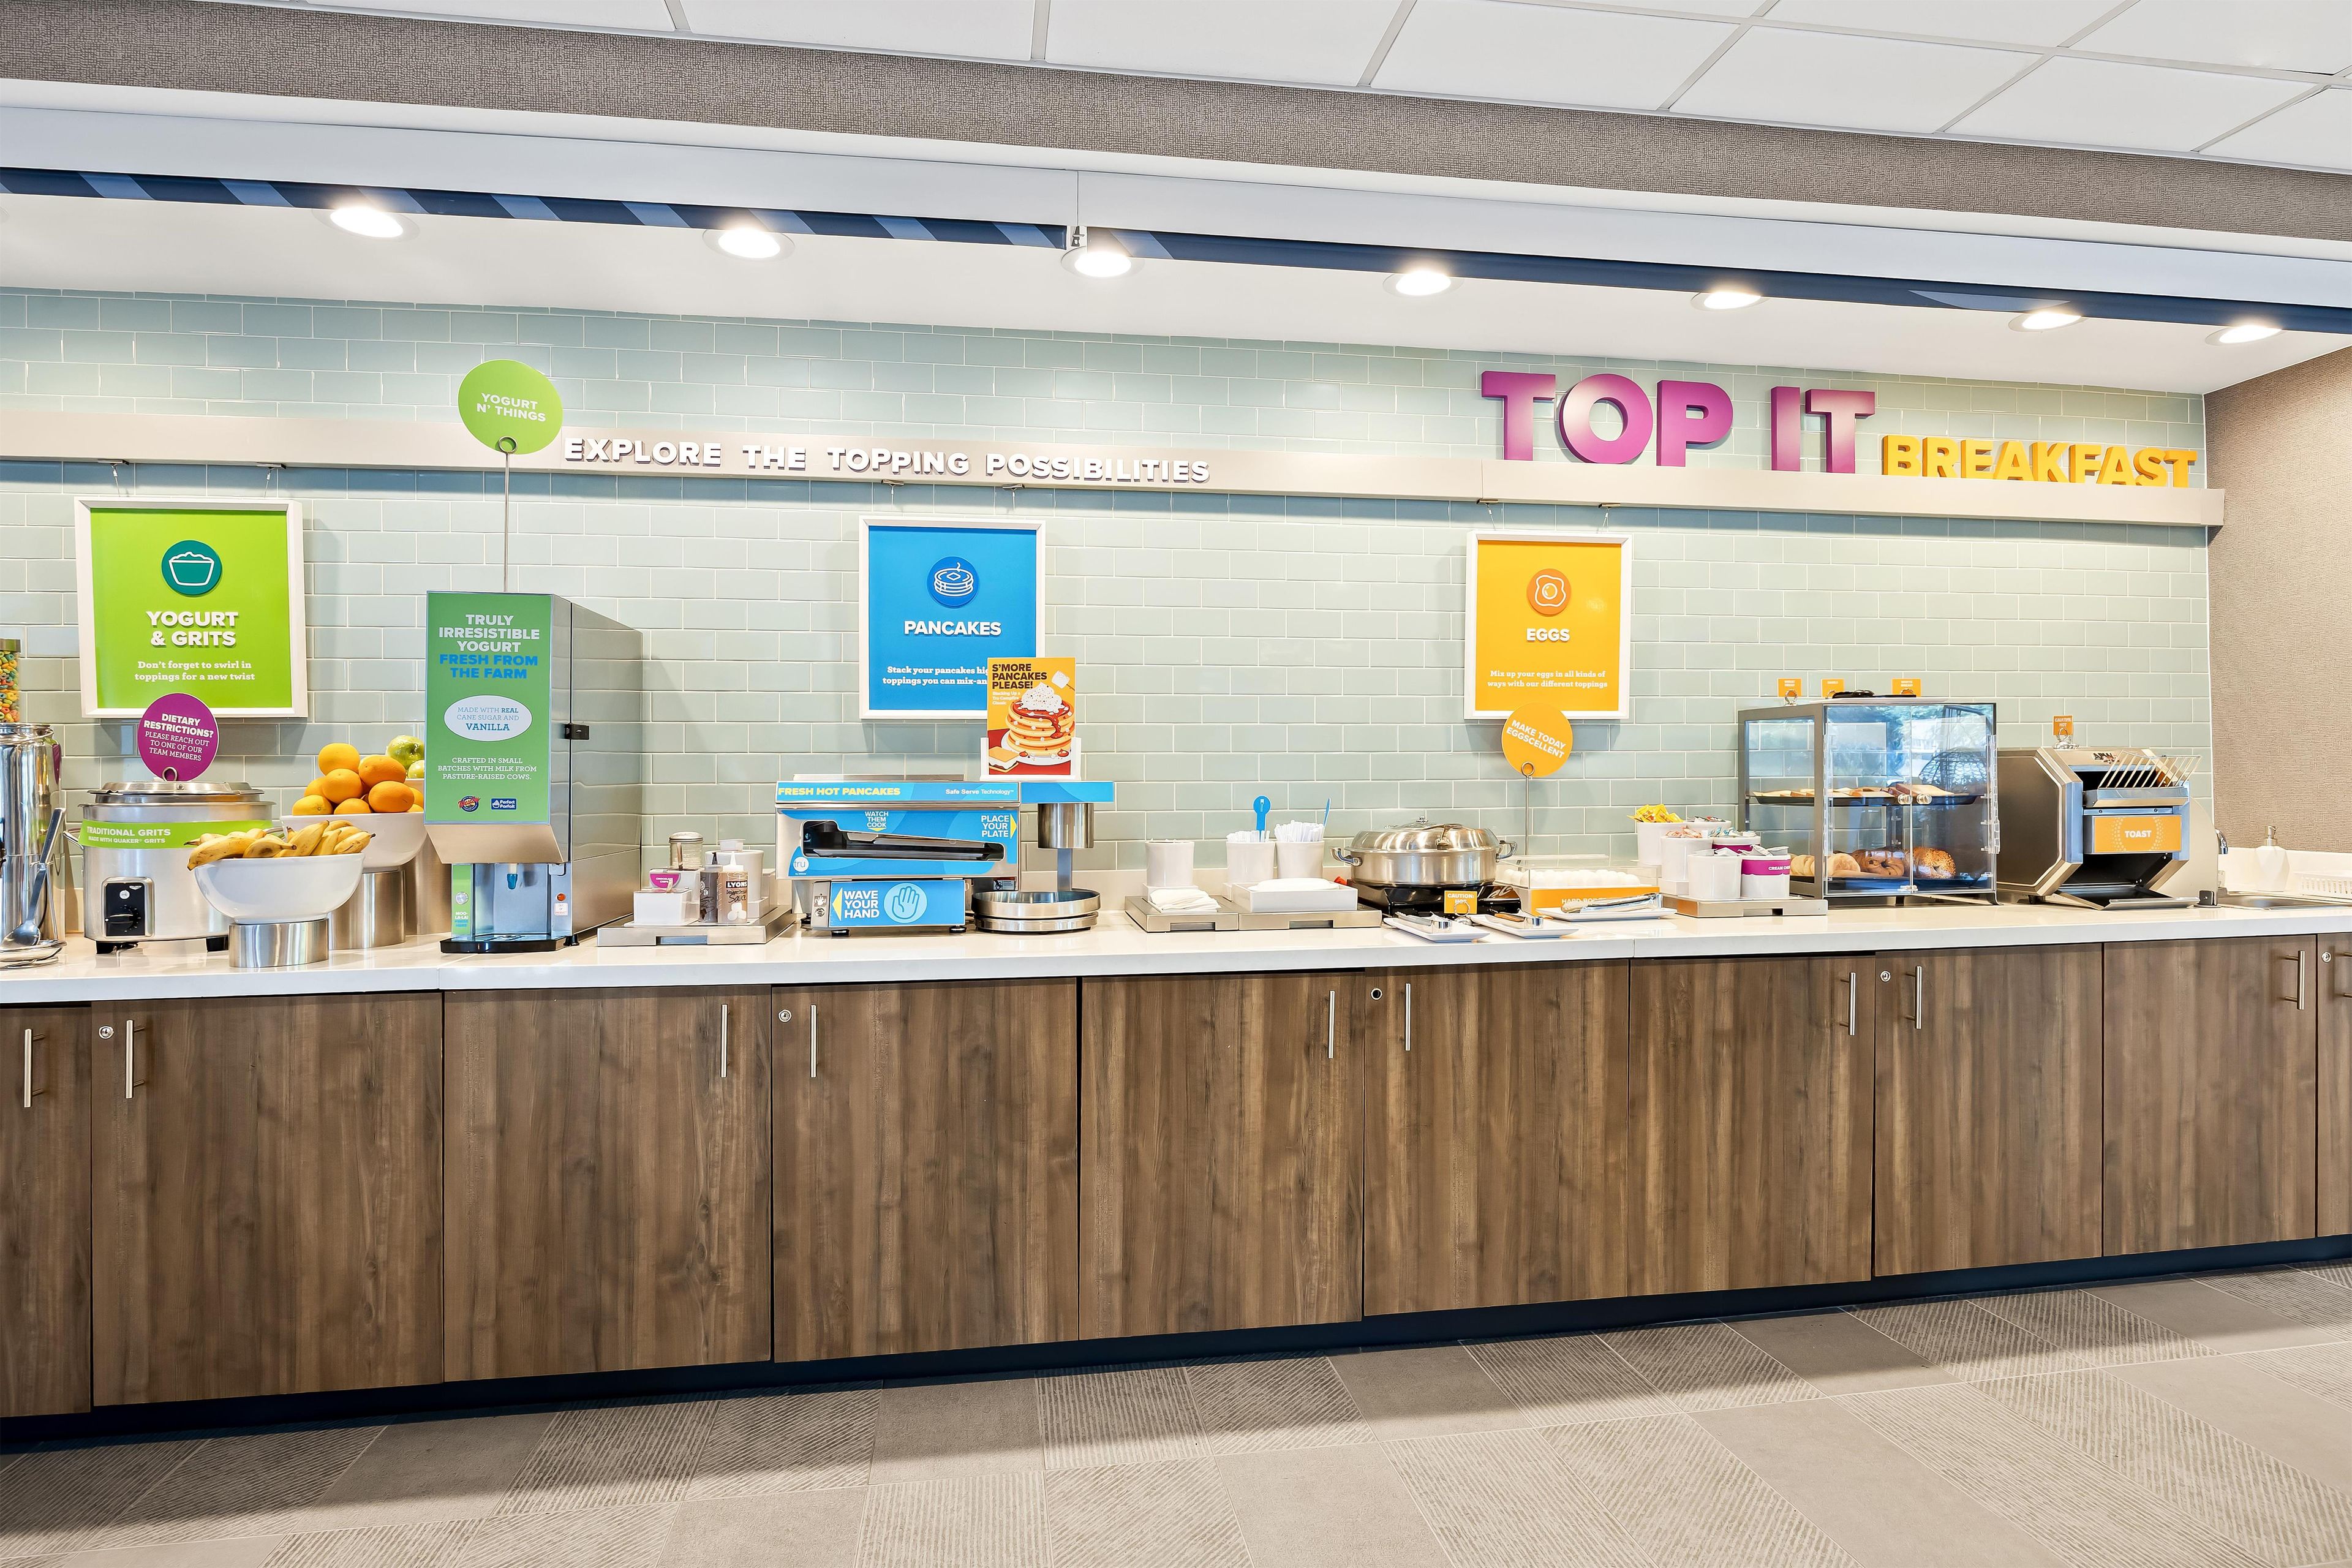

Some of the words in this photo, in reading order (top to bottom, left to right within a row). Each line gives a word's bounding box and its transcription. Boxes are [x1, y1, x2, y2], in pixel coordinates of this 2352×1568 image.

[481, 393, 538, 410] YOGURT
[477, 403, 491, 413] N'
[495, 405, 546, 422] THINGS
[1481, 371, 1733, 467] TOP
[1771, 386, 1875, 473] IT
[565, 437, 722, 466] EXPLORE
[742, 445, 806, 471] THE
[827, 447, 970, 476] TOPPING
[986, 453, 1210, 483] POSSIBILITIES
[1882, 435, 2197, 488] BREAKFAST
[146, 611, 239, 627] YOGURT
[466, 614, 514, 625] TRULY
[439, 627, 540, 639] IRRESISTIBLE
[904, 620, 1002, 636] PANCAKES
[151, 631, 167, 646] &
[172, 631, 236, 646] GRITS
[1526, 628, 1570, 642] EGGS
[457, 641, 521, 652] YOGURT
[168, 661, 200, 670] forget
[439, 654, 489, 665] FRESH
[493, 655, 538, 666] FROM
[450, 668, 480, 678] THE
[484, 668, 527, 679] FARM
[935, 666, 975, 675] pancakes
[992, 663, 1031, 672] S'MORE
[135, 673, 179, 682] toppings
[992, 672, 1047, 680] PANCAKES
[162, 713, 201, 726] DIETARY
[143, 720, 214, 738] RESTRICTIONS?
[1512, 720, 1537, 737] MAKE
[1538, 732, 1566, 749] TODAY
[145, 731, 169, 741] PLEASE
[170, 734, 194, 744] REACH
[1506, 726, 1565, 758] EGGSCELLENT
[149, 747, 168, 756] TEAM
[169, 750, 202, 761] MEMBERS
[86, 826, 135, 837] TRADITIONAL
[843, 890, 878, 899] WAVE
[845, 900, 878, 909] YOUR
[844, 909, 880, 918] HAND
